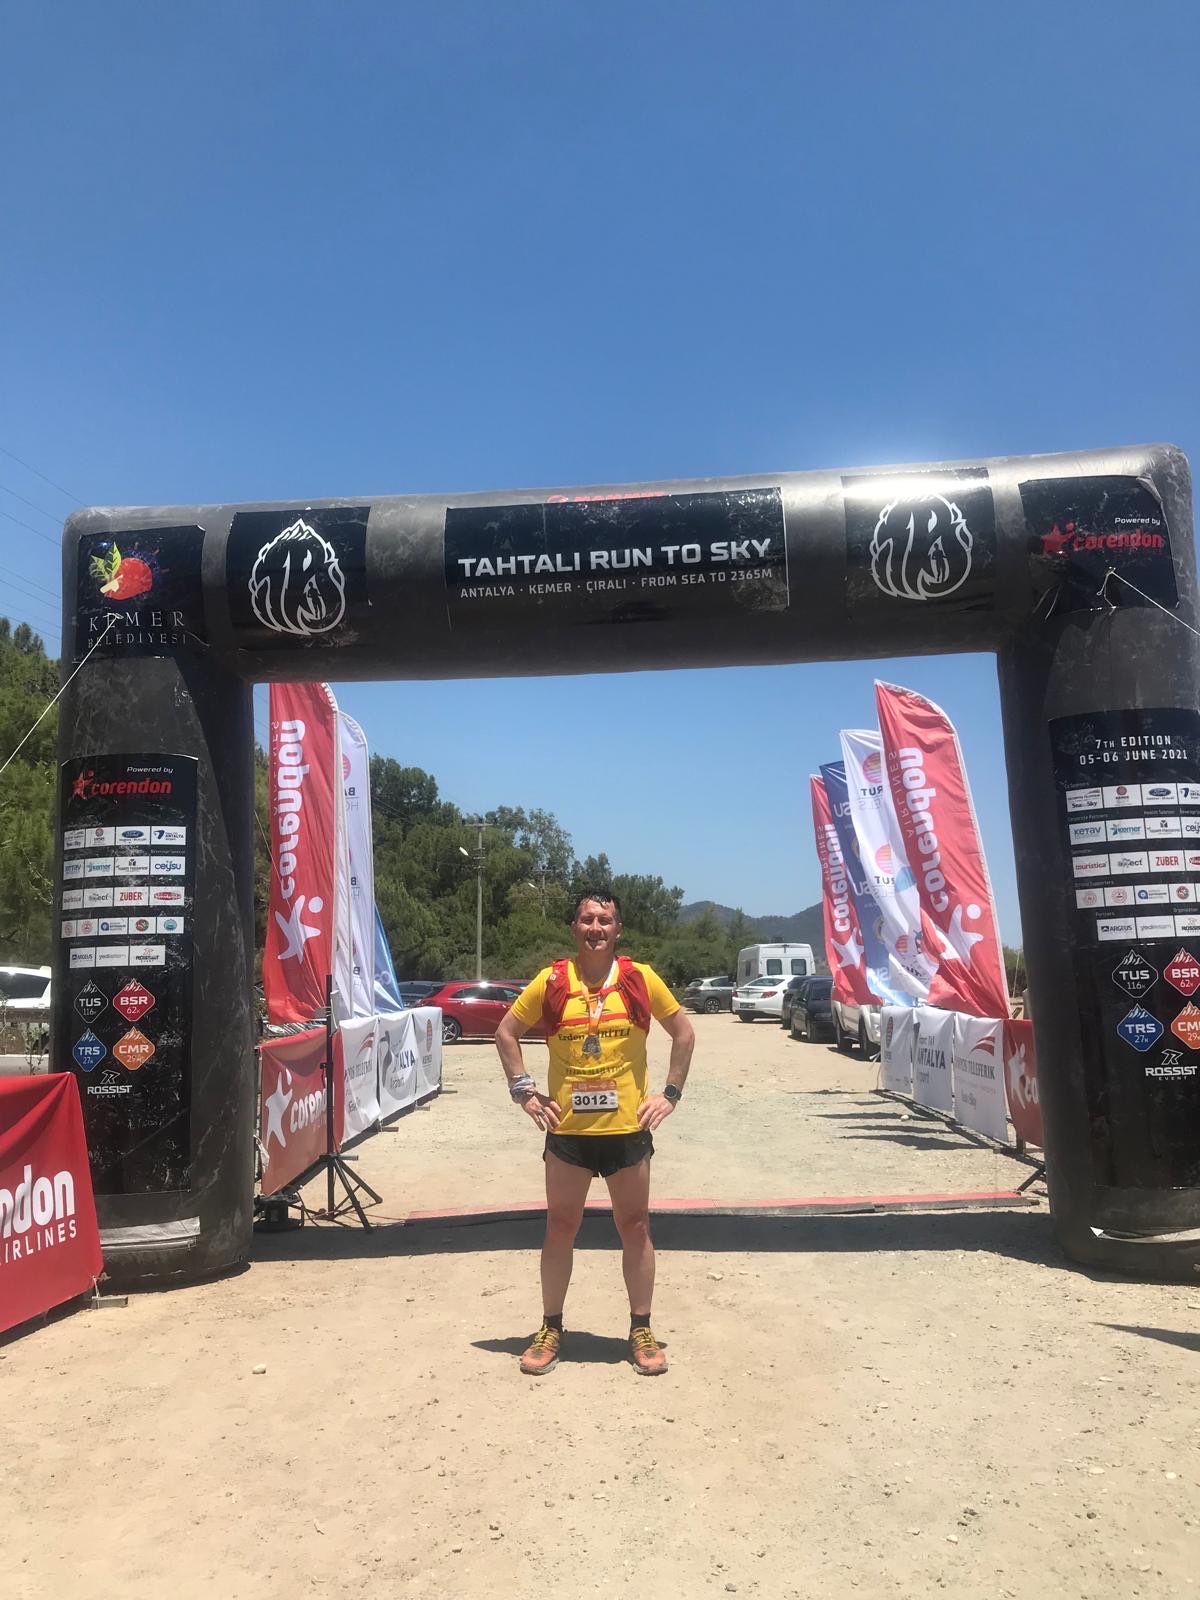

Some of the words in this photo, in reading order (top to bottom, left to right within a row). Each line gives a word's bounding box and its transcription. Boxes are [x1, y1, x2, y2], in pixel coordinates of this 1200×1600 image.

[1114, 517, 1150, 525] Powered
[1151, 517, 1161, 526] by
[1073, 528, 1163, 552] corendon
[458, 551, 581, 577] TAHTALI
[589, 547, 653, 569] RUN
[661, 544, 701, 565] TO
[710, 537, 771, 562] SKY
[460, 585, 515, 598] ANTALYA
[529, 583, 572, 595] KEMER
[641, 574, 677, 588] FROM
[681, 572, 705, 585] SEA
[709, 571, 727, 582] TO
[731, 568, 773, 581] 2365M
[89, 611, 184, 632] KEMER
[1095, 739, 1115, 749] 7TH
[1121, 735, 1171, 747] EDITION
[1080, 751, 1119, 765] 05-06
[1125, 749, 1157, 761] JUNE
[1161, 749, 1188, 760] 2021
[126, 766, 162, 774] Powered
[163, 766, 174, 774] by
[91, 777, 172, 796] corendon
[1119, 970, 1150, 980] TUS
[1171, 968, 1200, 978] BSR
[79, 997, 101, 1007] TUS
[120, 996, 148, 1005] BSR
[1125, 1023, 1156, 1034] TRS
[78, 1046, 100, 1056] TRS
[119, 1044, 149, 1055] CMR
[1145, 1066, 1198, 1077] ROSSIST
[87, 1085, 133, 1095] ROSSIST
[290, 1076, 334, 1134] corend
[574, 1095, 608, 1106] 3012
[0, 1164, 75, 1239] ndon
[0, 1219, 77, 1266] IRLINES
